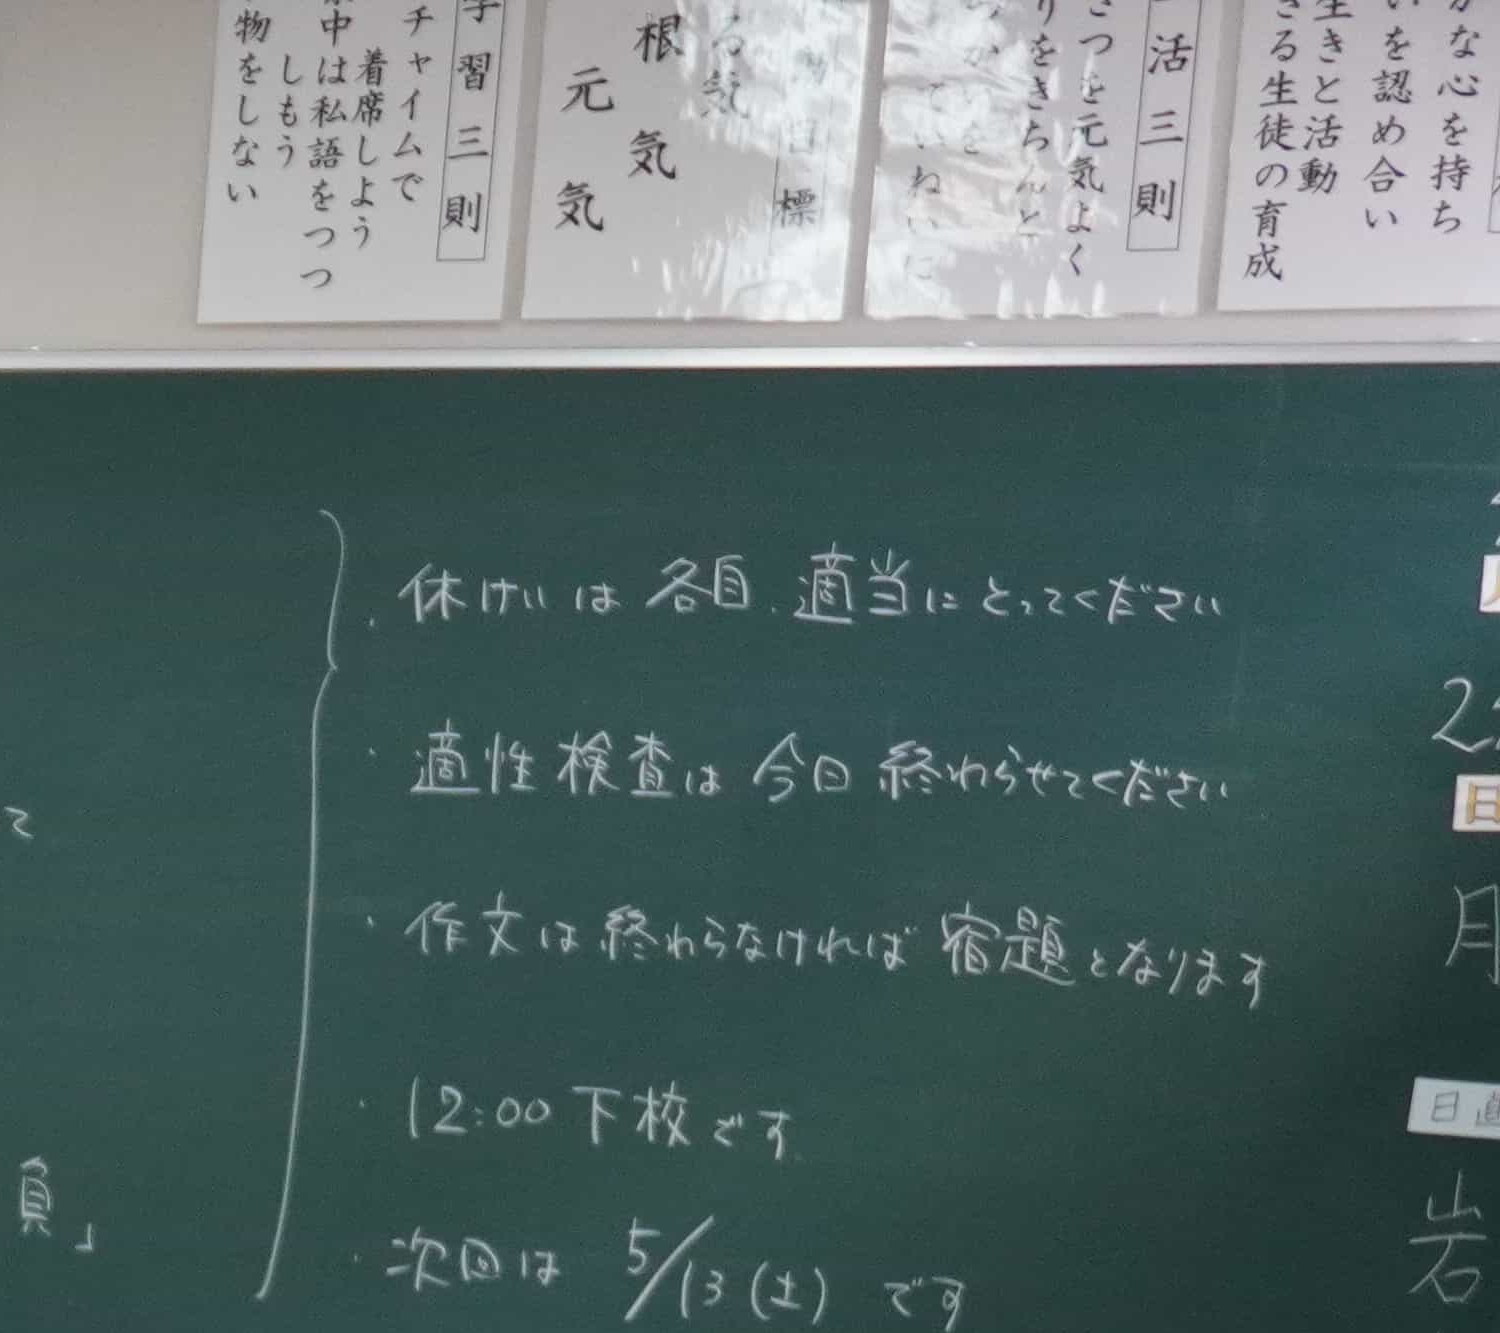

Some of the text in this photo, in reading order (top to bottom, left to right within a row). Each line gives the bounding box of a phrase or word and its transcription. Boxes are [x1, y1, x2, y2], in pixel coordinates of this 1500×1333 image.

[301, 0, 352, 289] 中は私語をつつ
[351, 47, 388, 249] 着席しよう
[1135, 0, 1193, 222] 活三則
[1363, 0, 1419, 229] を認め合い
[1430, 0, 1480, 234] な心を持ち
[1431, 678, 1500, 752] 2
